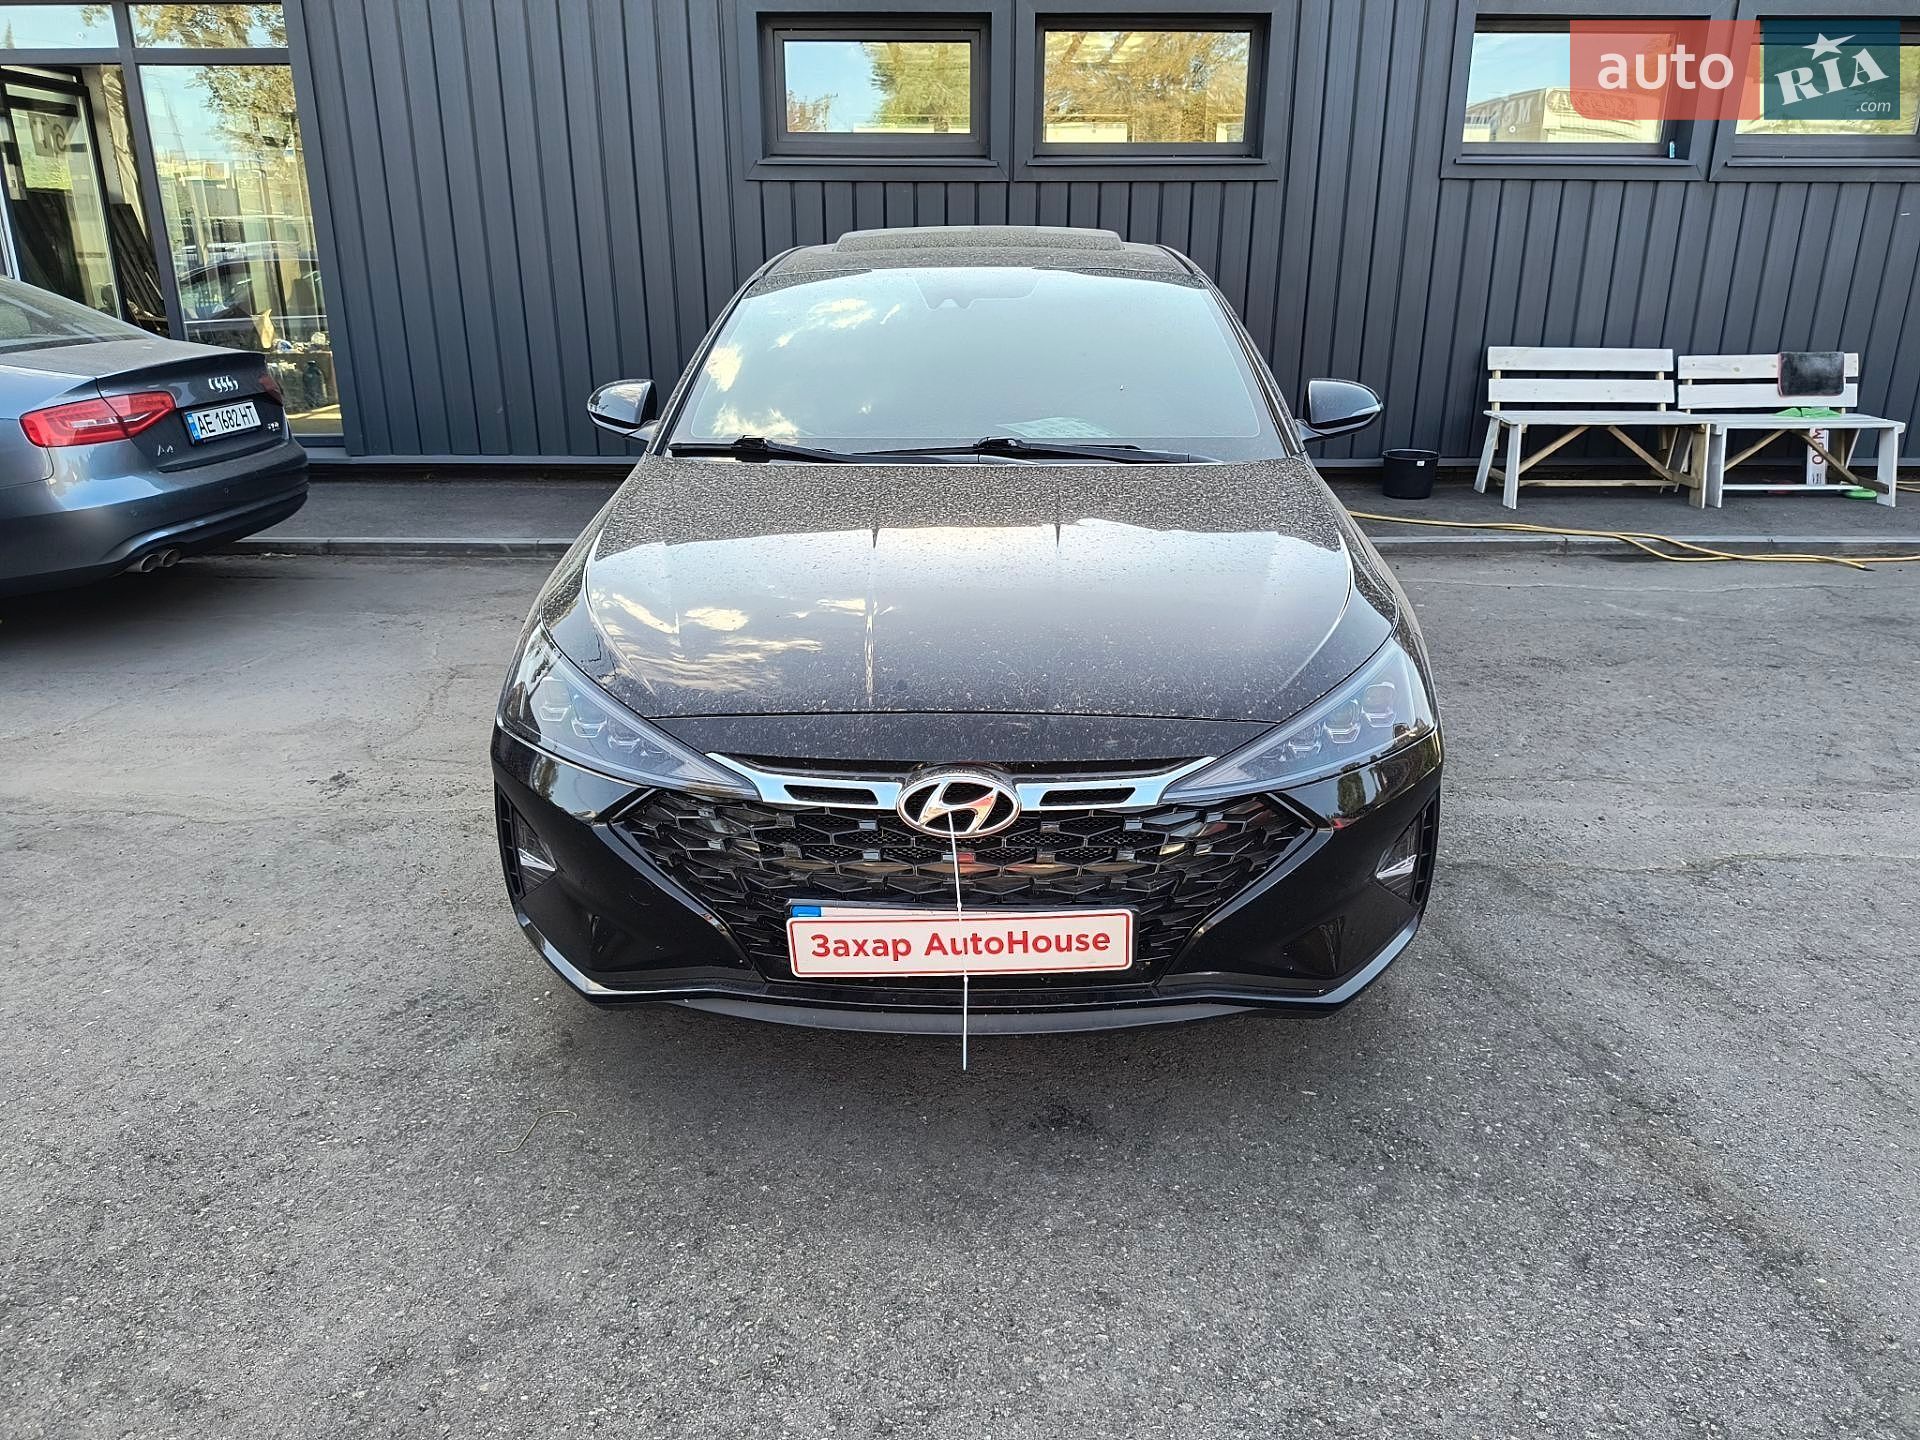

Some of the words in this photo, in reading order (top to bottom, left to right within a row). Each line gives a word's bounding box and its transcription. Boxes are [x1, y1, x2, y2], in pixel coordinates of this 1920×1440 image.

[197, 413, 217, 435] AE
[215, 408, 242, 431] 1682
[240, 405, 256, 426] HT
[810, 933, 912, 962] Захар
[924, 932, 1111, 957] AutoHouse
